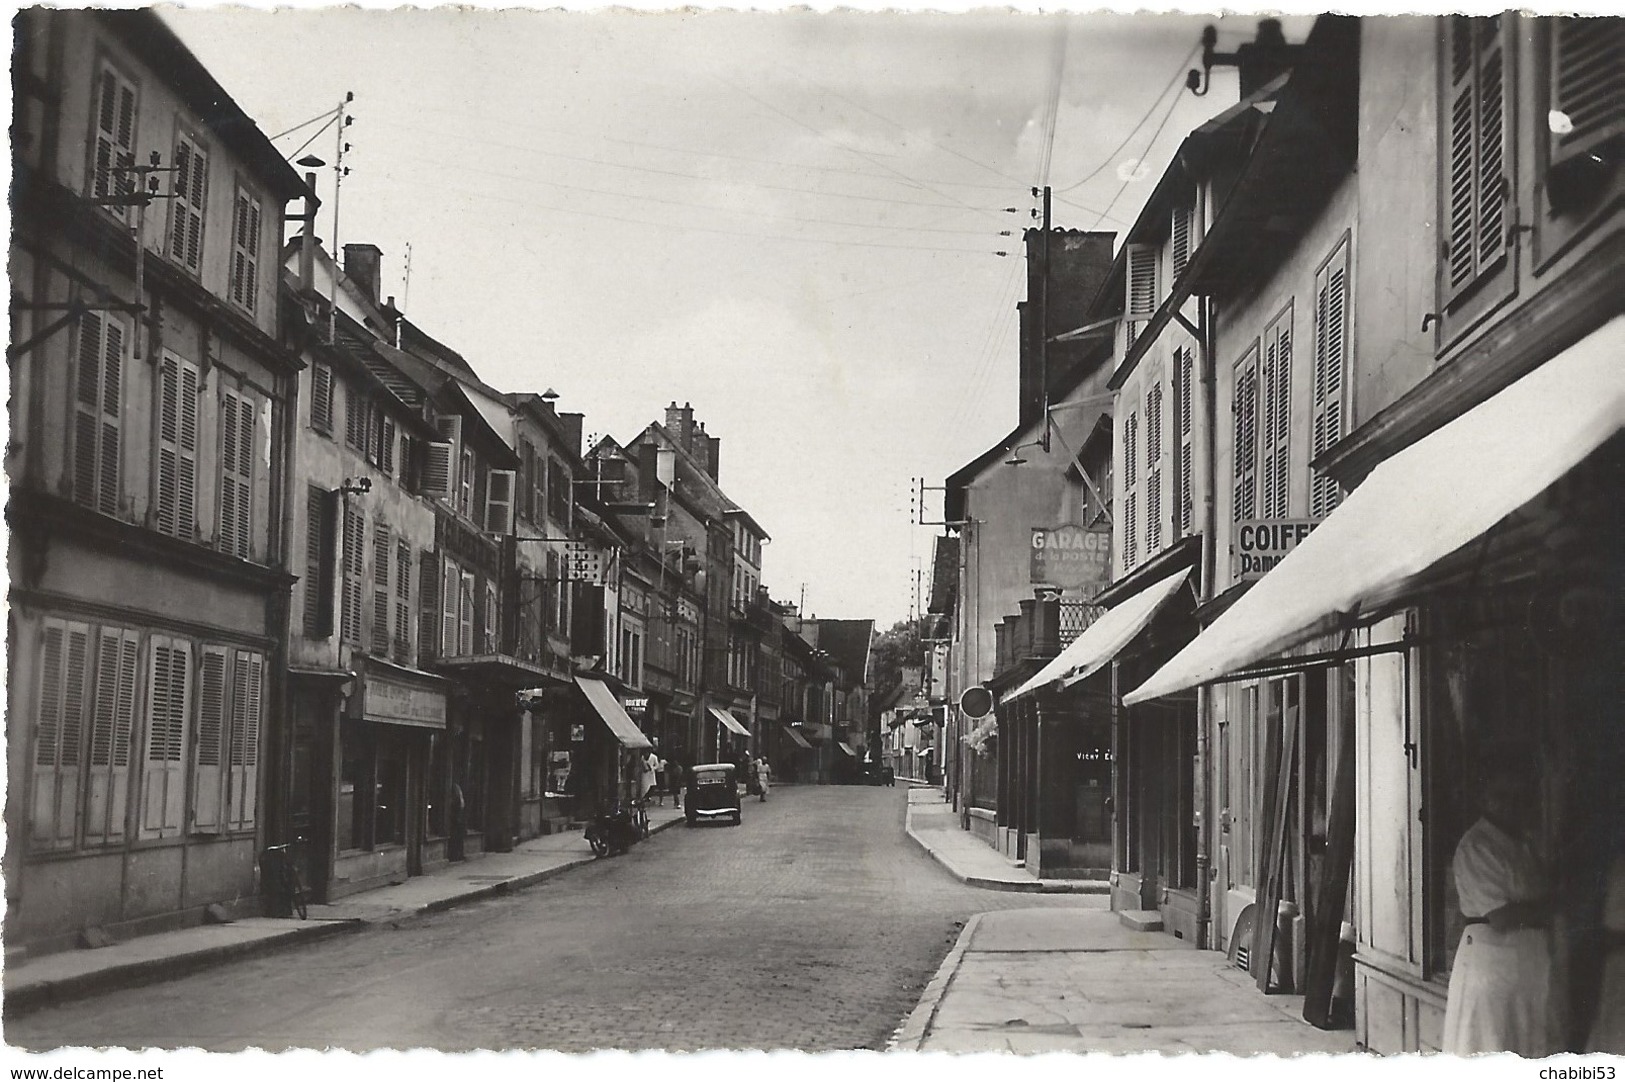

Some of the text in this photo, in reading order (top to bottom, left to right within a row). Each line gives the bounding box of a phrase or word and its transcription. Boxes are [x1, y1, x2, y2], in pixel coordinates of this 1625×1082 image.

[1032, 532, 1109, 550] GARAGE
[1240, 524, 1321, 551] COIFF
[1240, 553, 1286, 573] Dame
